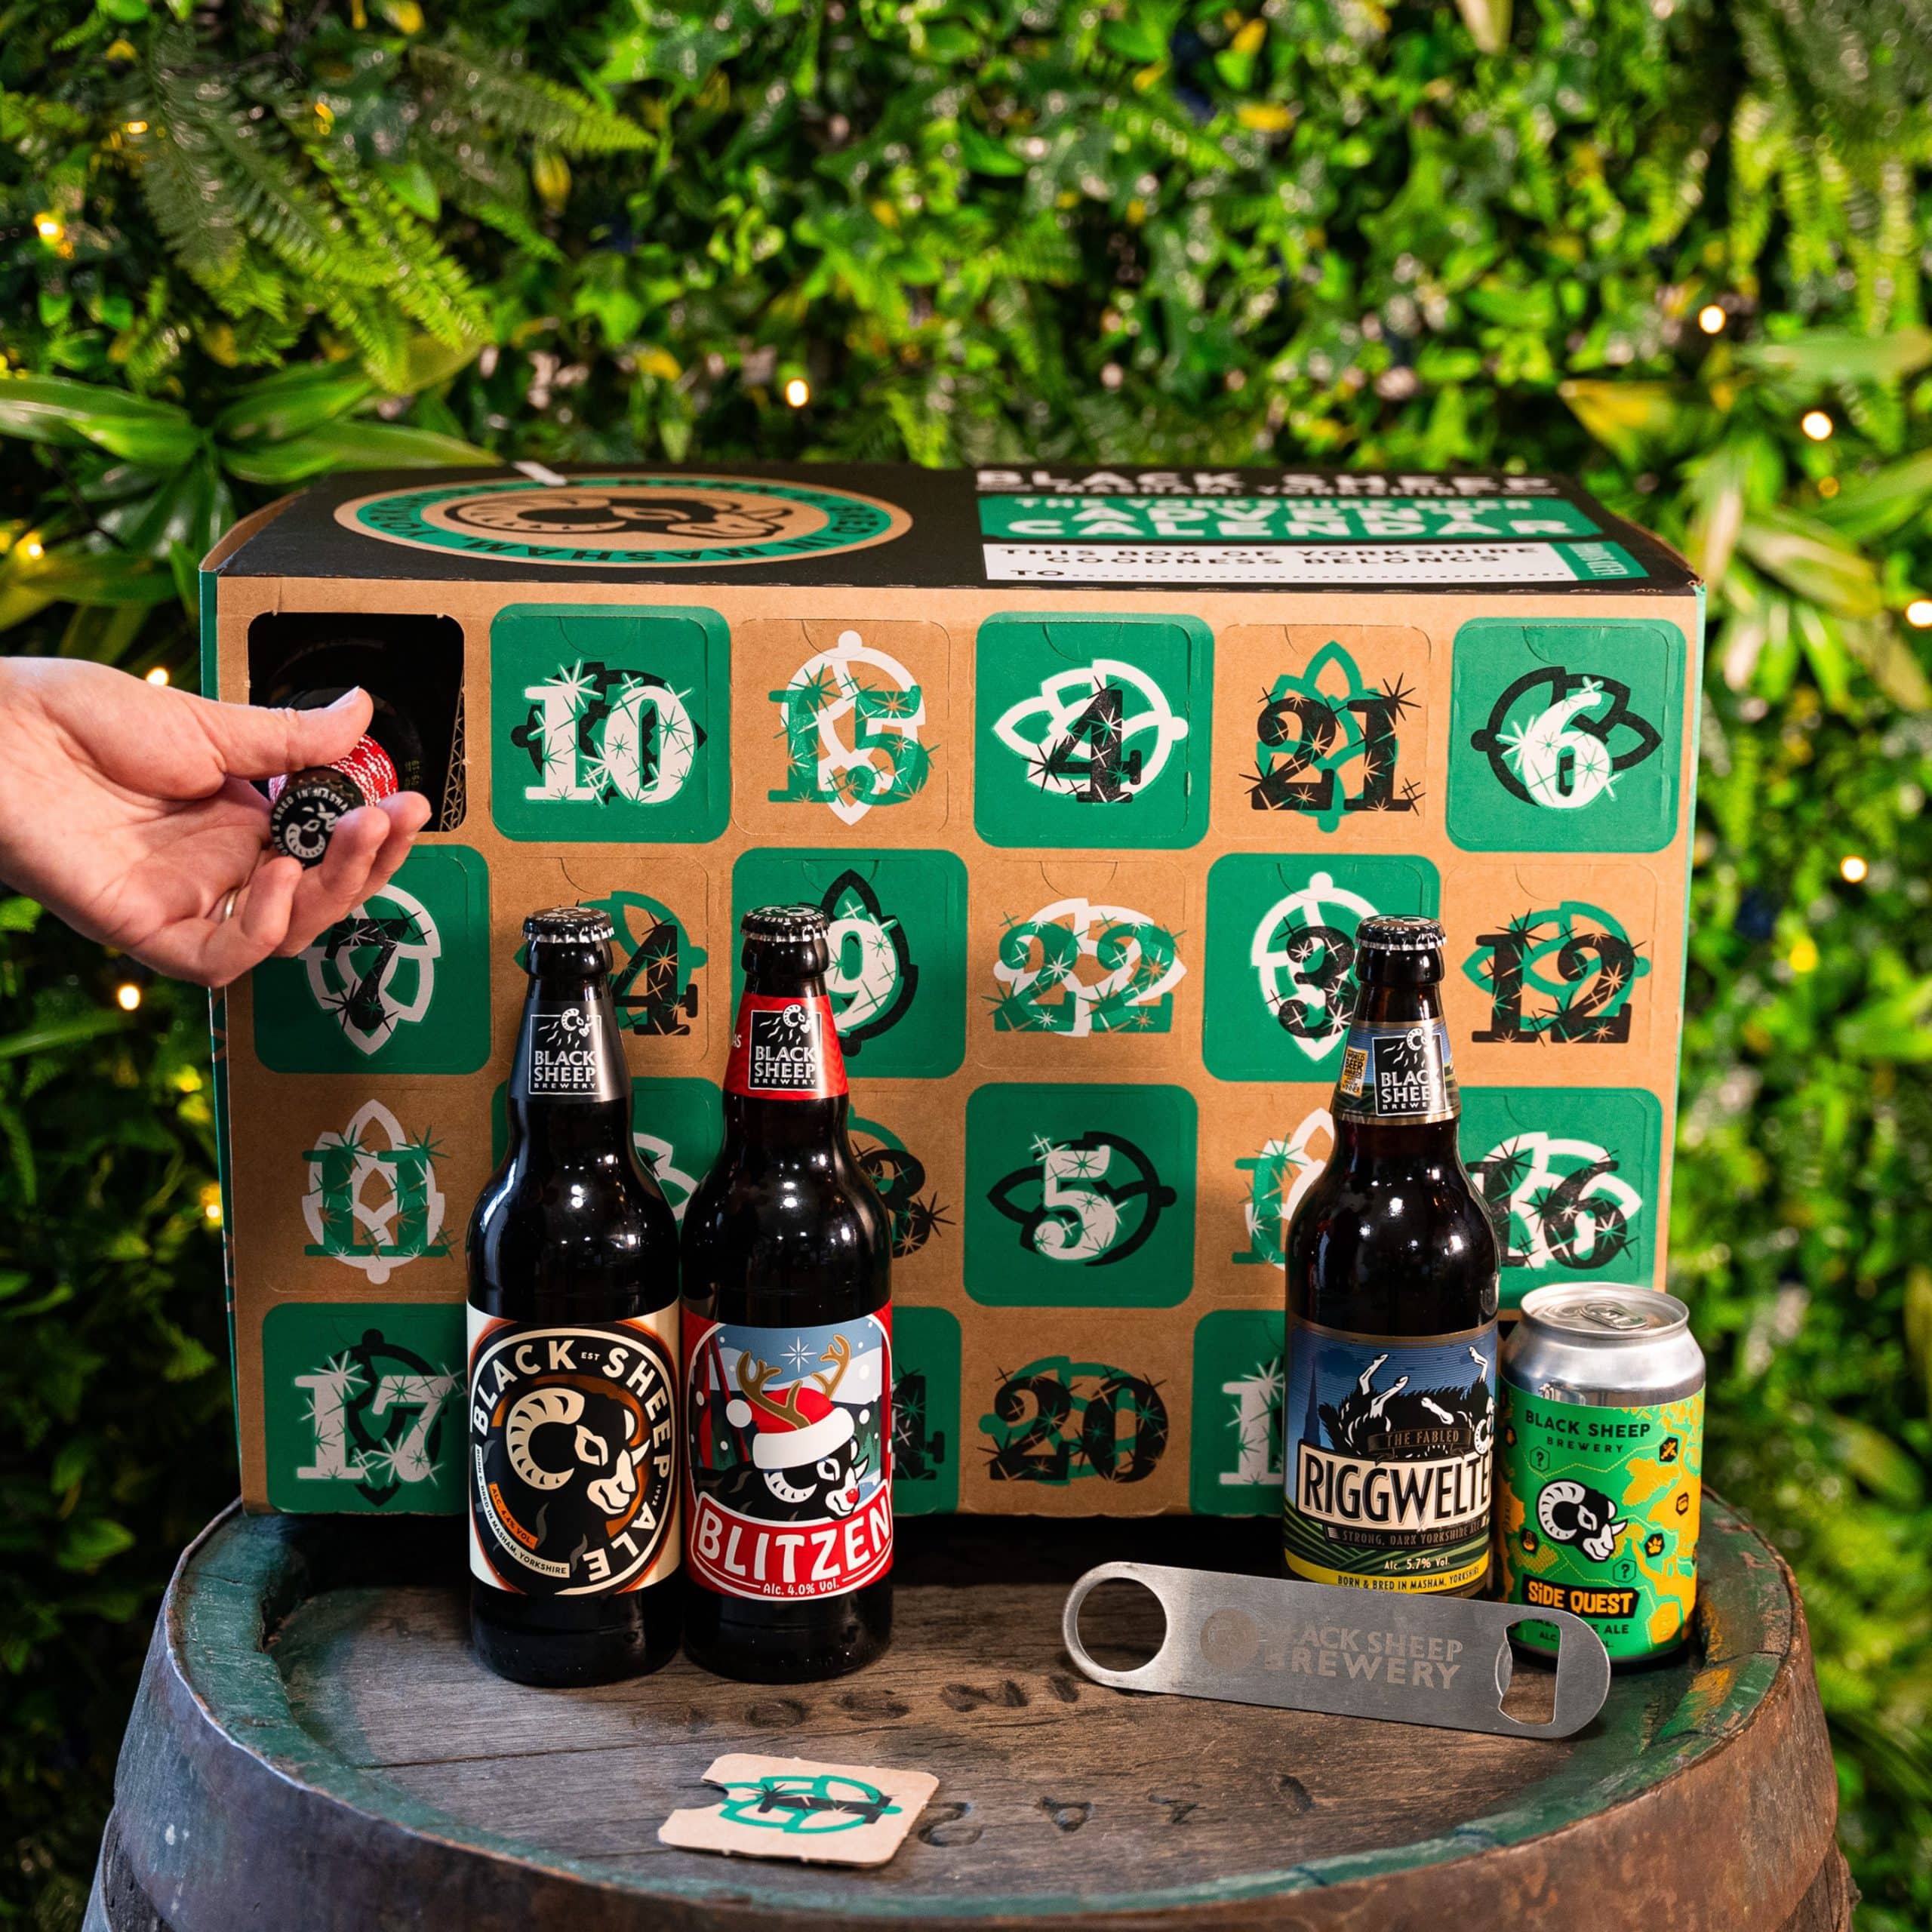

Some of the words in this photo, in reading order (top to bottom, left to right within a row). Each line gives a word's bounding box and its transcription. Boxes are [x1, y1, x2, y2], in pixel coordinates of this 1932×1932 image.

[977, 471, 1244, 488] BLACK
[1284, 473, 1549, 491] SHEEP
[1016, 498, 1105, 508] THE
[1126, 498, 1393, 509] YORKSHIRE
[1414, 500, 1532, 510] BEER
[1072, 506, 1484, 521] ADVENT
[778, 537, 844, 549] IN
[1008, 519, 1574, 536] CALENDAR
[1297, 548, 1537, 556] YORKSHIRE
[1303, 556, 1500, 565] BELONGS
[524, 678, 697, 804] 10
[766, 681, 931, 807] 15
[1038, 687, 1143, 804] 4
[1250, 693, 1414, 812] 21
[1520, 688, 1615, 810] 6
[273, 795, 294, 820] BRED
[297, 789, 309, 799] IN
[312, 787, 349, 811] MASHA
[323, 918, 411, 1031] 7
[608, 924, 698, 1036] 4
[826, 918, 898, 1032] 9
[992, 919, 1177, 1033] 22
[1278, 924, 1358, 1039] 3
[1471, 931, 1633, 1044] 12
[534, 1050, 595, 1066] BLACK
[534, 1066, 596, 1081] SHEEP
[755, 1045, 816, 1063] BLACK
[755, 1062, 815, 1078] SHEEP
[1345, 1059, 1364, 1072] BEER
[1381, 1087, 1434, 1103] SHEE
[302, 1143, 450, 1259] 11
[1032, 1143, 1118, 1261] 5
[1231, 1153, 1286, 1266] 1
[1465, 1158, 1629, 1271] 16
[473, 1340, 577, 1437] BLACK
[601, 1347, 672, 1478] SHEEP
[294, 1372, 454, 1483] 17
[580, 1351, 601, 1361] EST
[652, 1484, 663, 1507] 1992
[989, 1375, 1170, 1484] 20
[1218, 1380, 1285, 1486] 1
[1386, 1430, 1411, 1447] THE
[1416, 1429, 1460, 1445] FABLED
[1525, 1409, 1580, 1435] BLACK
[1588, 1423, 1651, 1438] SHEEP
[1547, 1436, 1624, 1454] BREWERY
[491, 1487, 502, 1508] ALC.
[501, 1510, 516, 1530] 4.4%
[516, 1527, 534, 1546] VOL.
[1304, 1451, 1494, 1524] RIGGWELTE
[481, 1485, 489, 1508] BRED
[487, 1509, 493, 1519] IN
[492, 1520, 518, 1556] MASHAM,
[519, 1552, 568, 1574] YORKSHIRE
[583, 1501, 657, 1582] ALE
[698, 1495, 891, 1584] BLITZEN
[1343, 1529, 1386, 1546] STRONG,
[1389, 1531, 1417, 1546] DARK
[1420, 1524, 1469, 1546] YORKSHIRE
[763, 1582, 785, 1595] Alc.
[787, 1583, 816, 1595] 4.0%
[819, 1577, 840, 1592] Vol.
[1337, 1574, 1360, 1587] BORN
[1363, 1580, 1370, 1589] &
[1372, 1580, 1395, 1591] BRED
[1398, 1580, 1407, 1591] IN
[1410, 1577, 1447, 1591] MASHAM,
[1448, 1566, 1480, 1585] YORKSHIRE
[1384, 1559, 1401, 1571] Alc.
[1406, 1557, 1432, 1571] 5.7%
[1435, 1555, 1450, 1567] Vol.
[1570, 1589, 1634, 1616] QUEST
[1604, 1623, 1629, 1635] ALE
[1367, 1631, 1464, 1663] SHEEP
